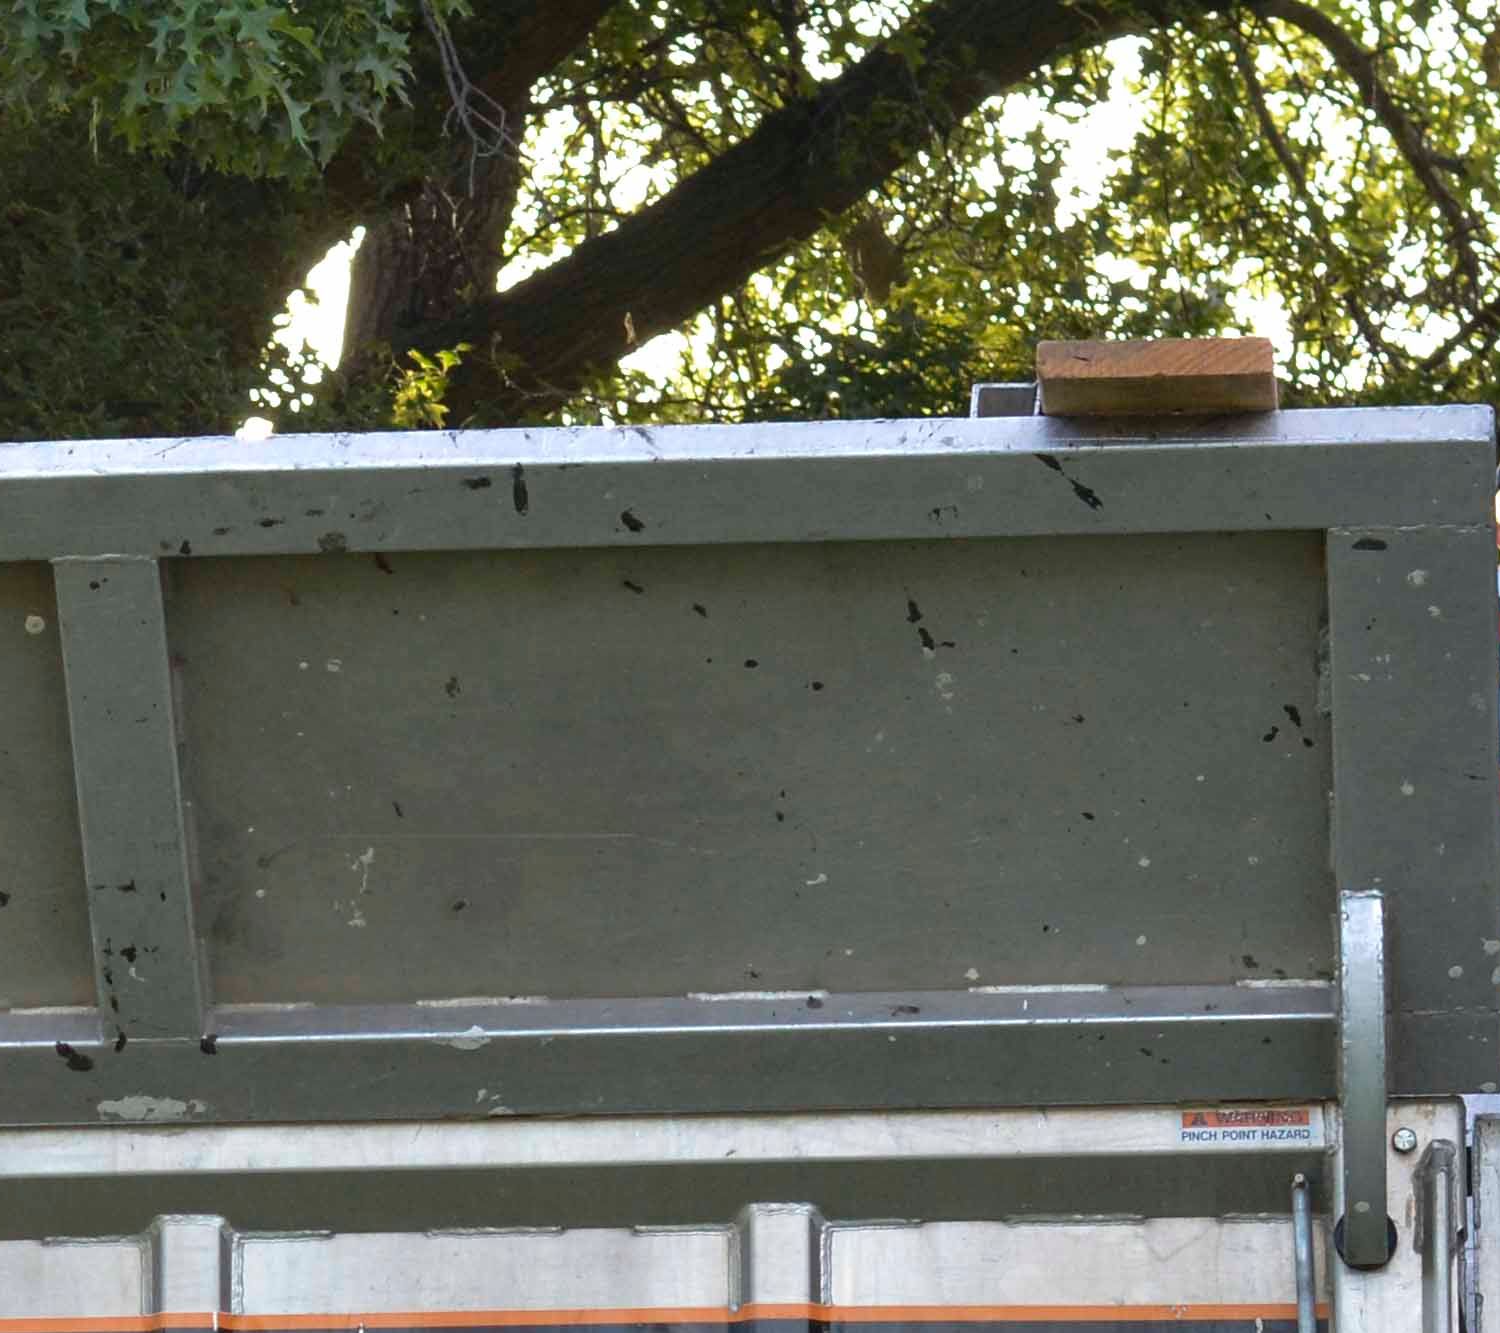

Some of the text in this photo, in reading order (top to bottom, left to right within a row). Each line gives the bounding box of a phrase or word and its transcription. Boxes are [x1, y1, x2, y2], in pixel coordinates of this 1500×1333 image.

[1181, 1128, 1311, 1141] PINCH POINT HAZARD
